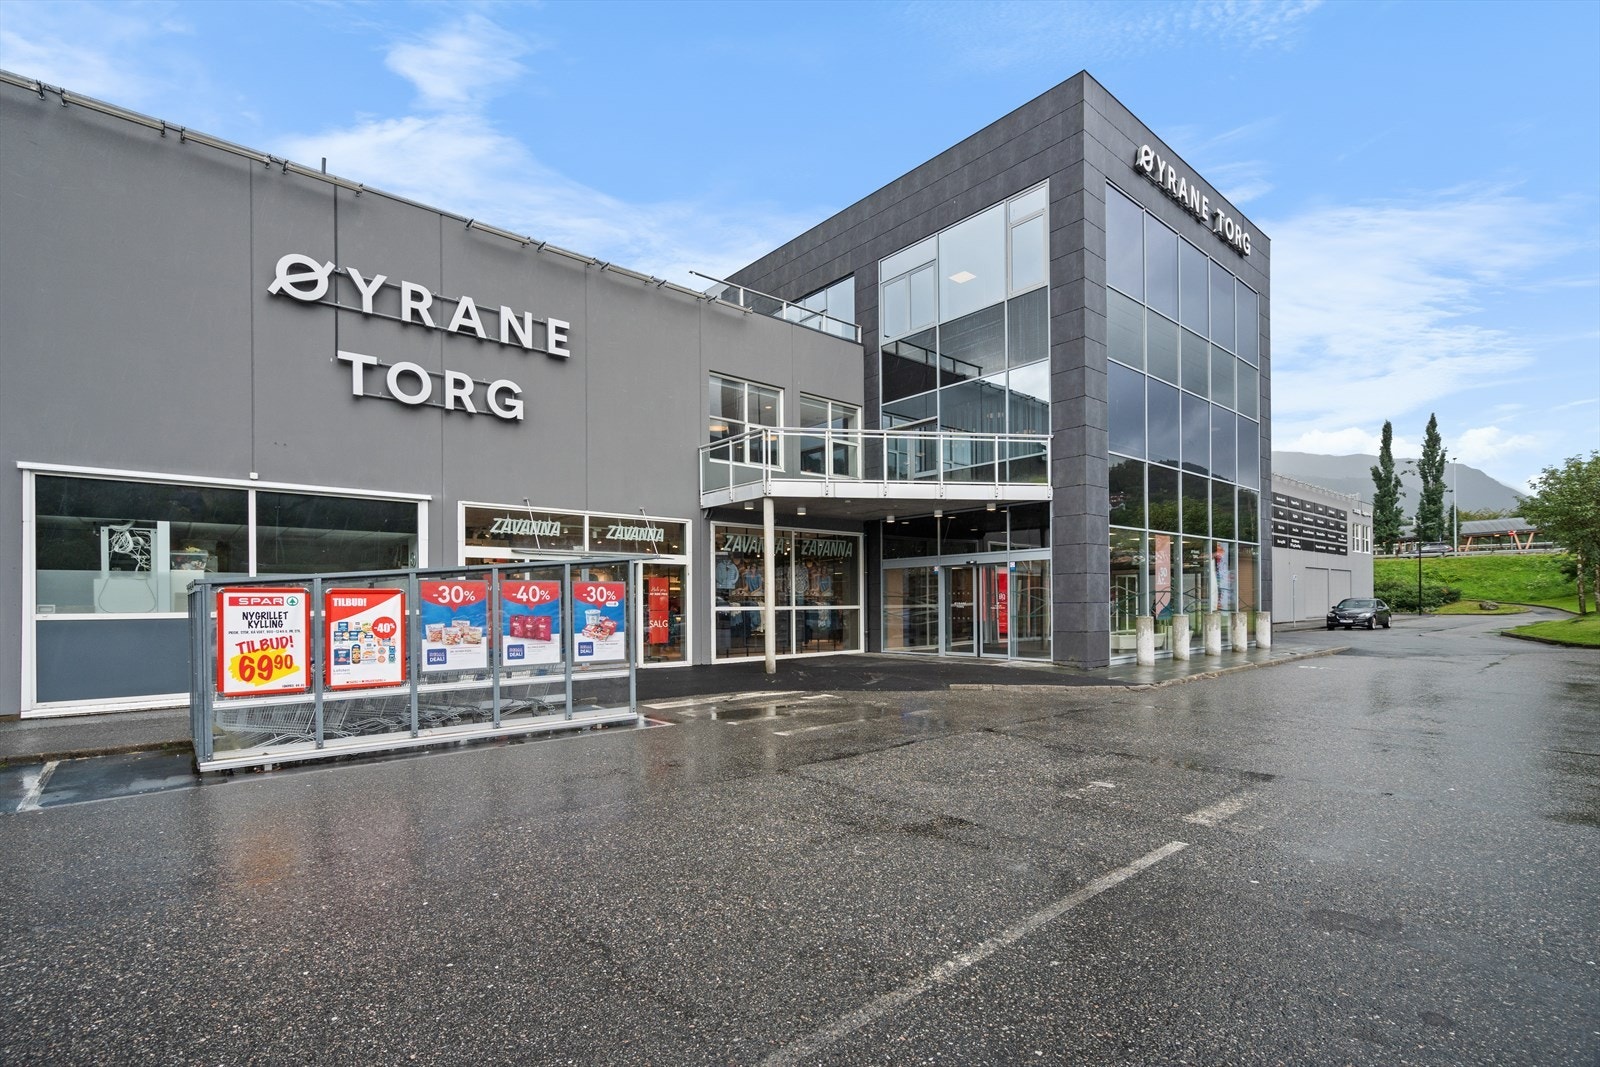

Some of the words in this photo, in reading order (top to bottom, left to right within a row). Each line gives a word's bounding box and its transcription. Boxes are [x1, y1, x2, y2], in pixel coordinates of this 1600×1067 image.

[1136, 144, 1209, 221] ØYRANE
[1214, 208, 1250, 256] TORG
[267, 253, 571, 358] ØYRANE
[337, 349, 524, 421] TORG
[489, 517, 561, 537] ZAVANNA
[605, 525, 665, 543] ZAVANNA
[722, 534, 785, 555] ZAVANA
[801, 539, 853, 558] ZAVANNA
[238, 597, 284, 606] SPAR
[332, 597, 367, 607] TILBUD!
[432, 585, 476, 604] -30%
[512, 585, 551, 602] -40%
[582, 586, 617, 602] -30%
[242, 610, 289, 621] NYGRILLET
[247, 619, 284, 629] KYLLING
[649, 619, 669, 628] SALG
[235, 635, 294, 654] TILBUD!
